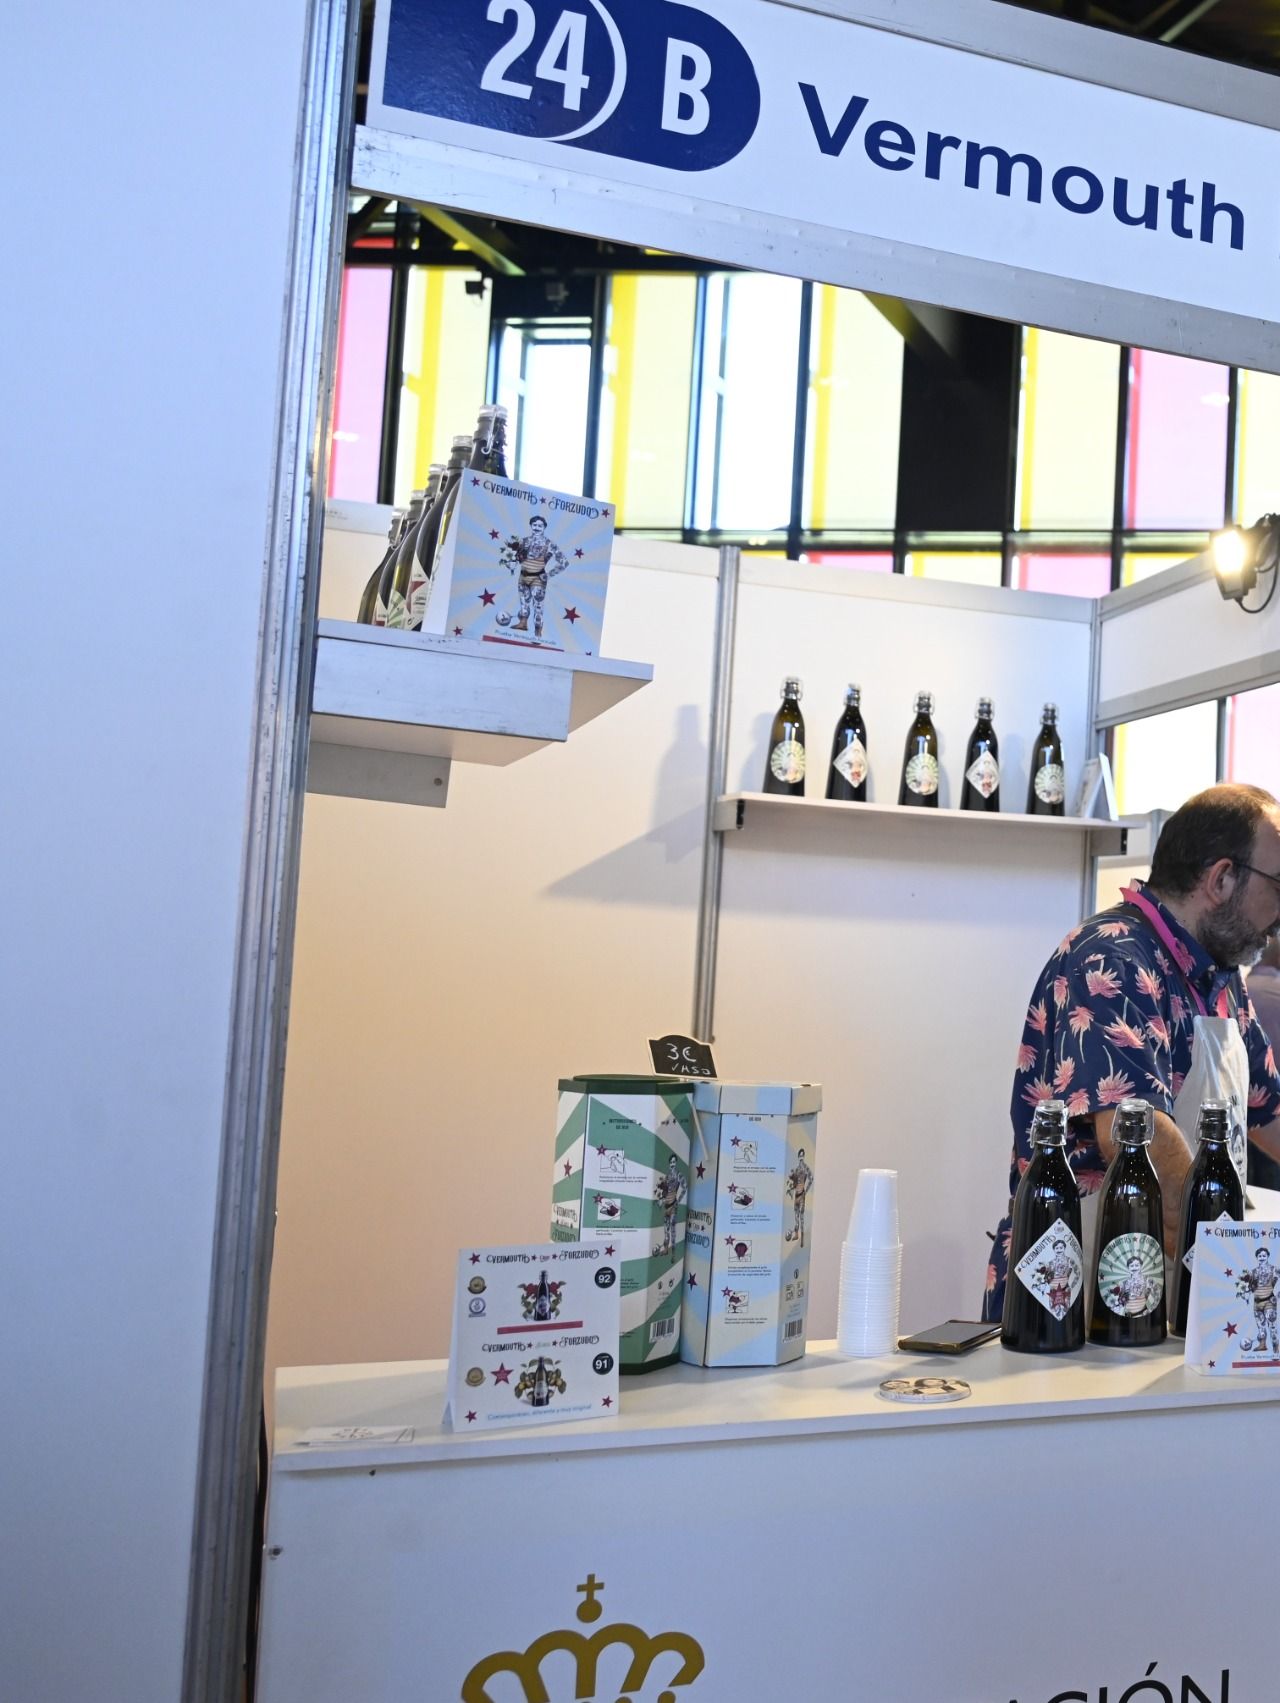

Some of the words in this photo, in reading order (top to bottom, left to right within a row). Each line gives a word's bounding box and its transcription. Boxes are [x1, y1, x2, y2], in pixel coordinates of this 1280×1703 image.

[480, 0, 590, 111] 24
[661, 37, 712, 136] B
[797, 81, 1246, 251] Vermouth
[483, 480, 538, 506] VERMOUTH
[548, 496, 600, 520] FORZUDO
[1214, 1227, 1260, 1239] VERMOUTH
[486, 1253, 530, 1264] VERMOUTH
[560, 1249, 599, 1260] FORZUDO
[1020, 1234, 1057, 1269] VERMOUTH
[598, 1274, 611, 1284] 92
[482, 1341, 526, 1352] VERMOUTH
[560, 1335, 600, 1347] FORZUDO
[595, 1359, 607, 1370] 91
